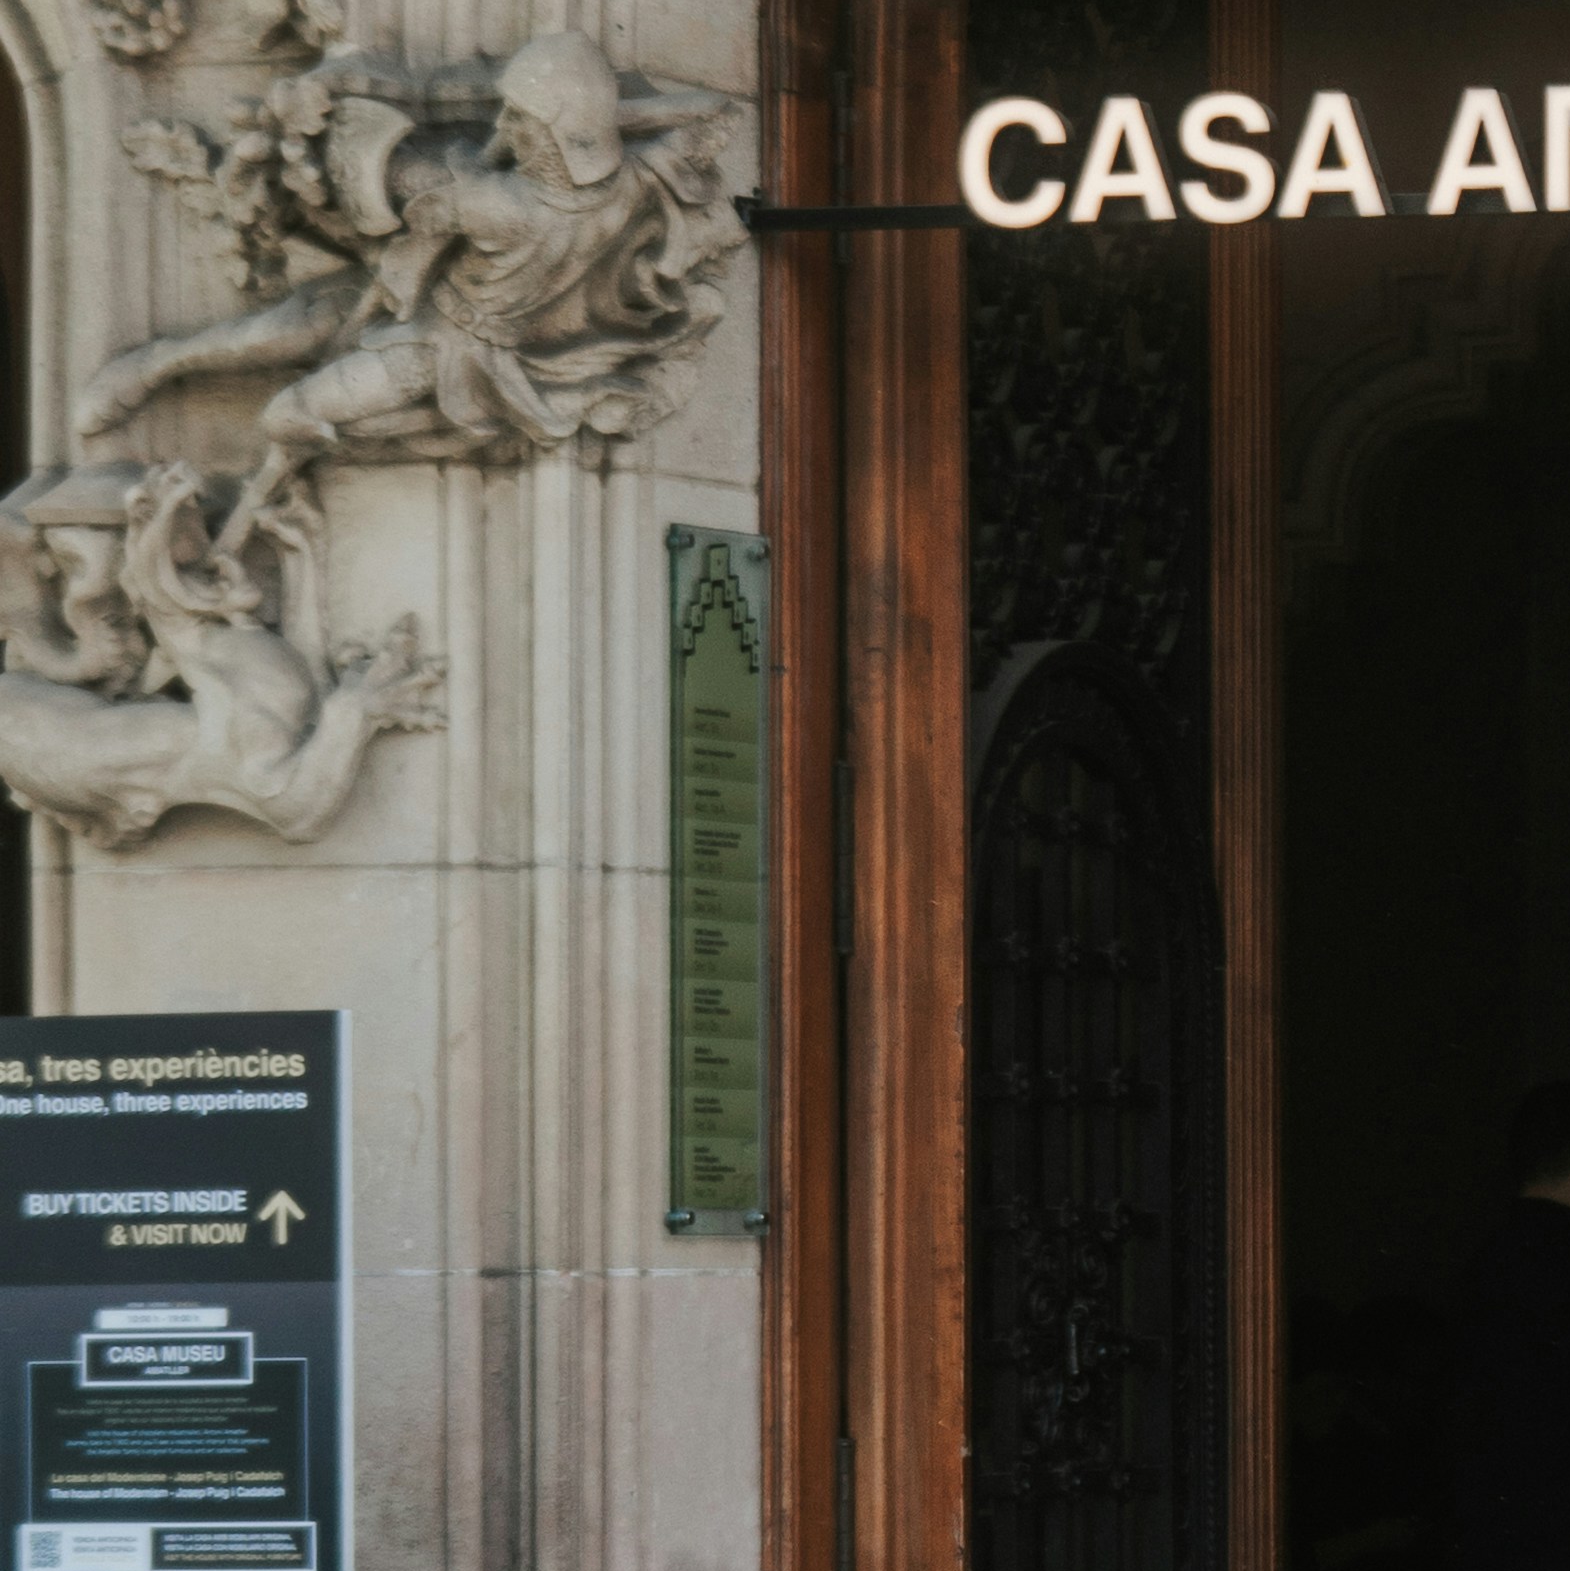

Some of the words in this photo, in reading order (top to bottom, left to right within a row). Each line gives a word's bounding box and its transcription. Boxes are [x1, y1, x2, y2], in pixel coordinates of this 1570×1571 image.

[958, 91, 1386, 228] CASA
[41, 1055, 101, 1082] tres
[108, 1048, 306, 1088] experiències
[0, 1094, 32, 1115] ne
[36, 1092, 110, 1116] house,
[114, 1091, 171, 1114] three
[175, 1089, 309, 1116] experiences
[27, 1192, 76, 1216] BUY
[76, 1191, 170, 1216] TICKETS
[172, 1189, 248, 1214] INSIDE
[109, 1224, 127, 1246] &
[131, 1223, 188, 1245] VISIT
[190, 1222, 248, 1244] NOW
[108, 1345, 159, 1364] CASA
[161, 1344, 226, 1363] MUSEU
